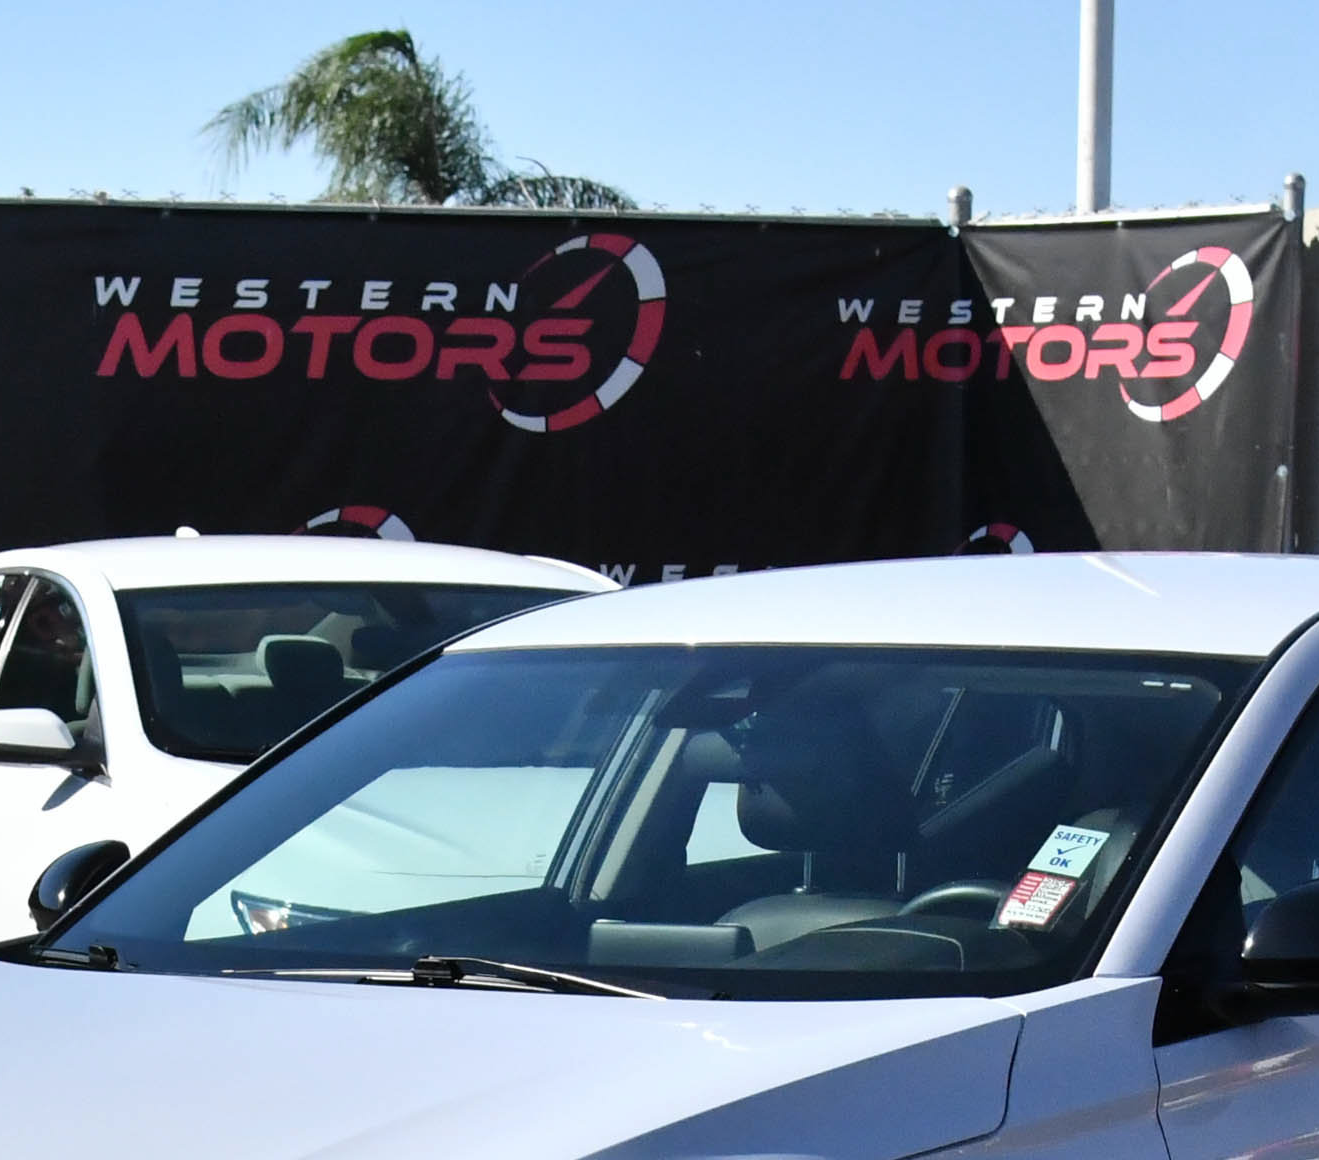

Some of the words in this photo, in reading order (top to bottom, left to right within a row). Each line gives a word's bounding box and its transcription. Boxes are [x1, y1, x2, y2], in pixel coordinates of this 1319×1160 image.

[95, 276, 518, 311] WESTERN
[838, 292, 1147, 324] WESTERN
[97, 313, 594, 380] MOTORS
[840, 321, 1200, 382] MOTORS
[1054, 830, 1103, 847] SAFETY
[1049, 856, 1072, 868] OK
